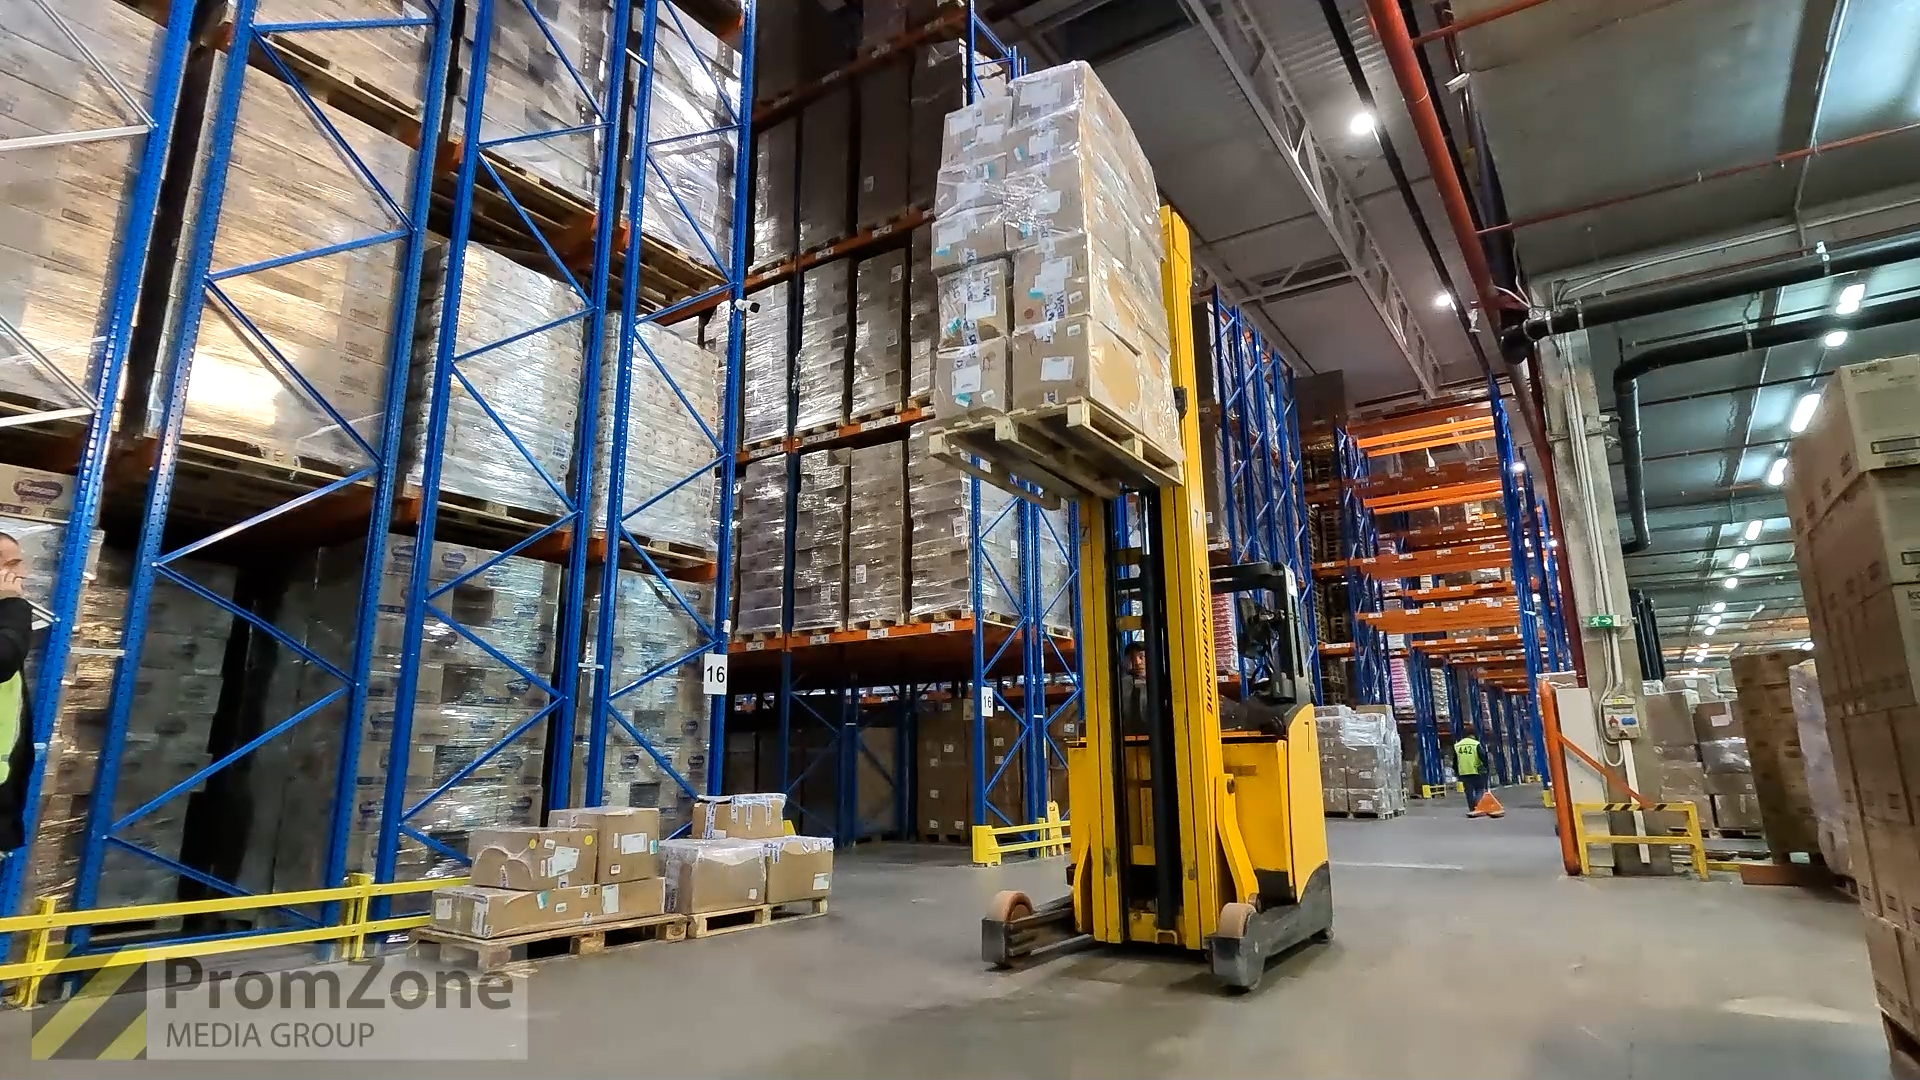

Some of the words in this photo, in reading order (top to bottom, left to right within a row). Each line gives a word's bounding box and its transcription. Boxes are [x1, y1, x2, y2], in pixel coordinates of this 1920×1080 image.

[1198, 567, 1214, 715] JUNGHEINRICH
[706, 665, 725, 683] 16
[983, 695, 992, 709] 16
[1458, 746, 1473, 755] 442
